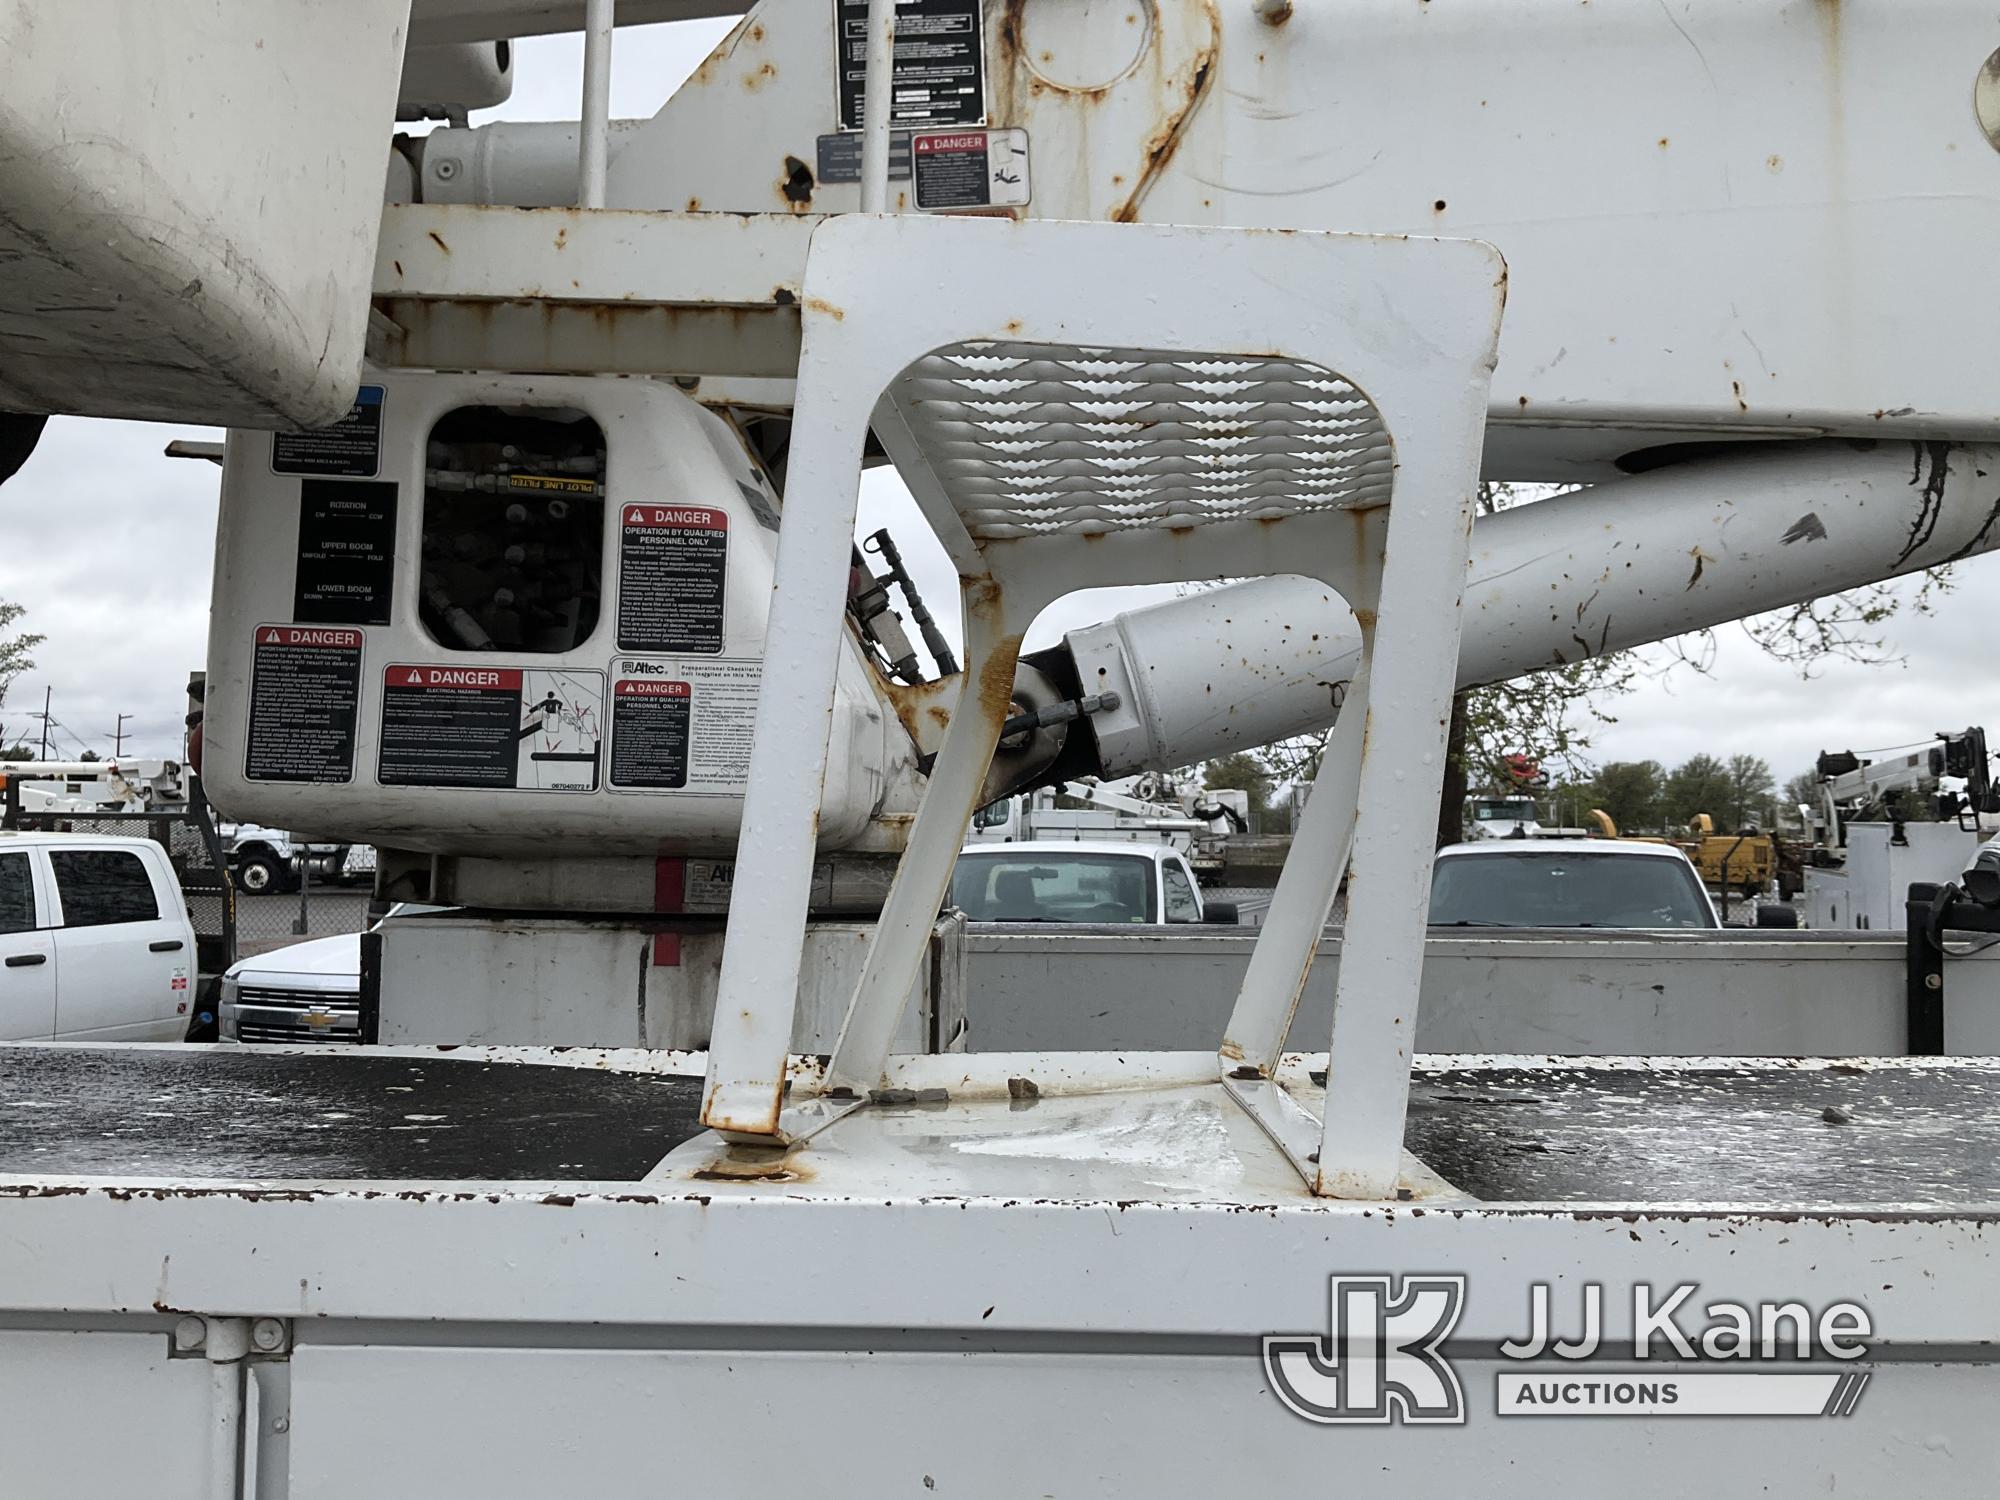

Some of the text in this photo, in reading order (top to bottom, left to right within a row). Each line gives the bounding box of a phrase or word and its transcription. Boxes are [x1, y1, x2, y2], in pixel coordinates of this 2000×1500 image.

[934, 138, 982, 150] DANGER
[510, 478, 593, 492] PILOT LINE FILTER
[330, 502, 367, 510] ROTATION
[656, 510, 711, 524] DANGER
[625, 527, 670, 536] OPERATION
[684, 530, 725, 538] QUALIFIED
[350, 543, 373, 551] BOOM
[640, 537, 686, 545] PERSONNEL
[290, 631, 354, 644] DANGER
[634, 662, 664, 675] Altec
[430, 670, 499, 685] DANGER
[638, 684, 682, 693] DANGER
